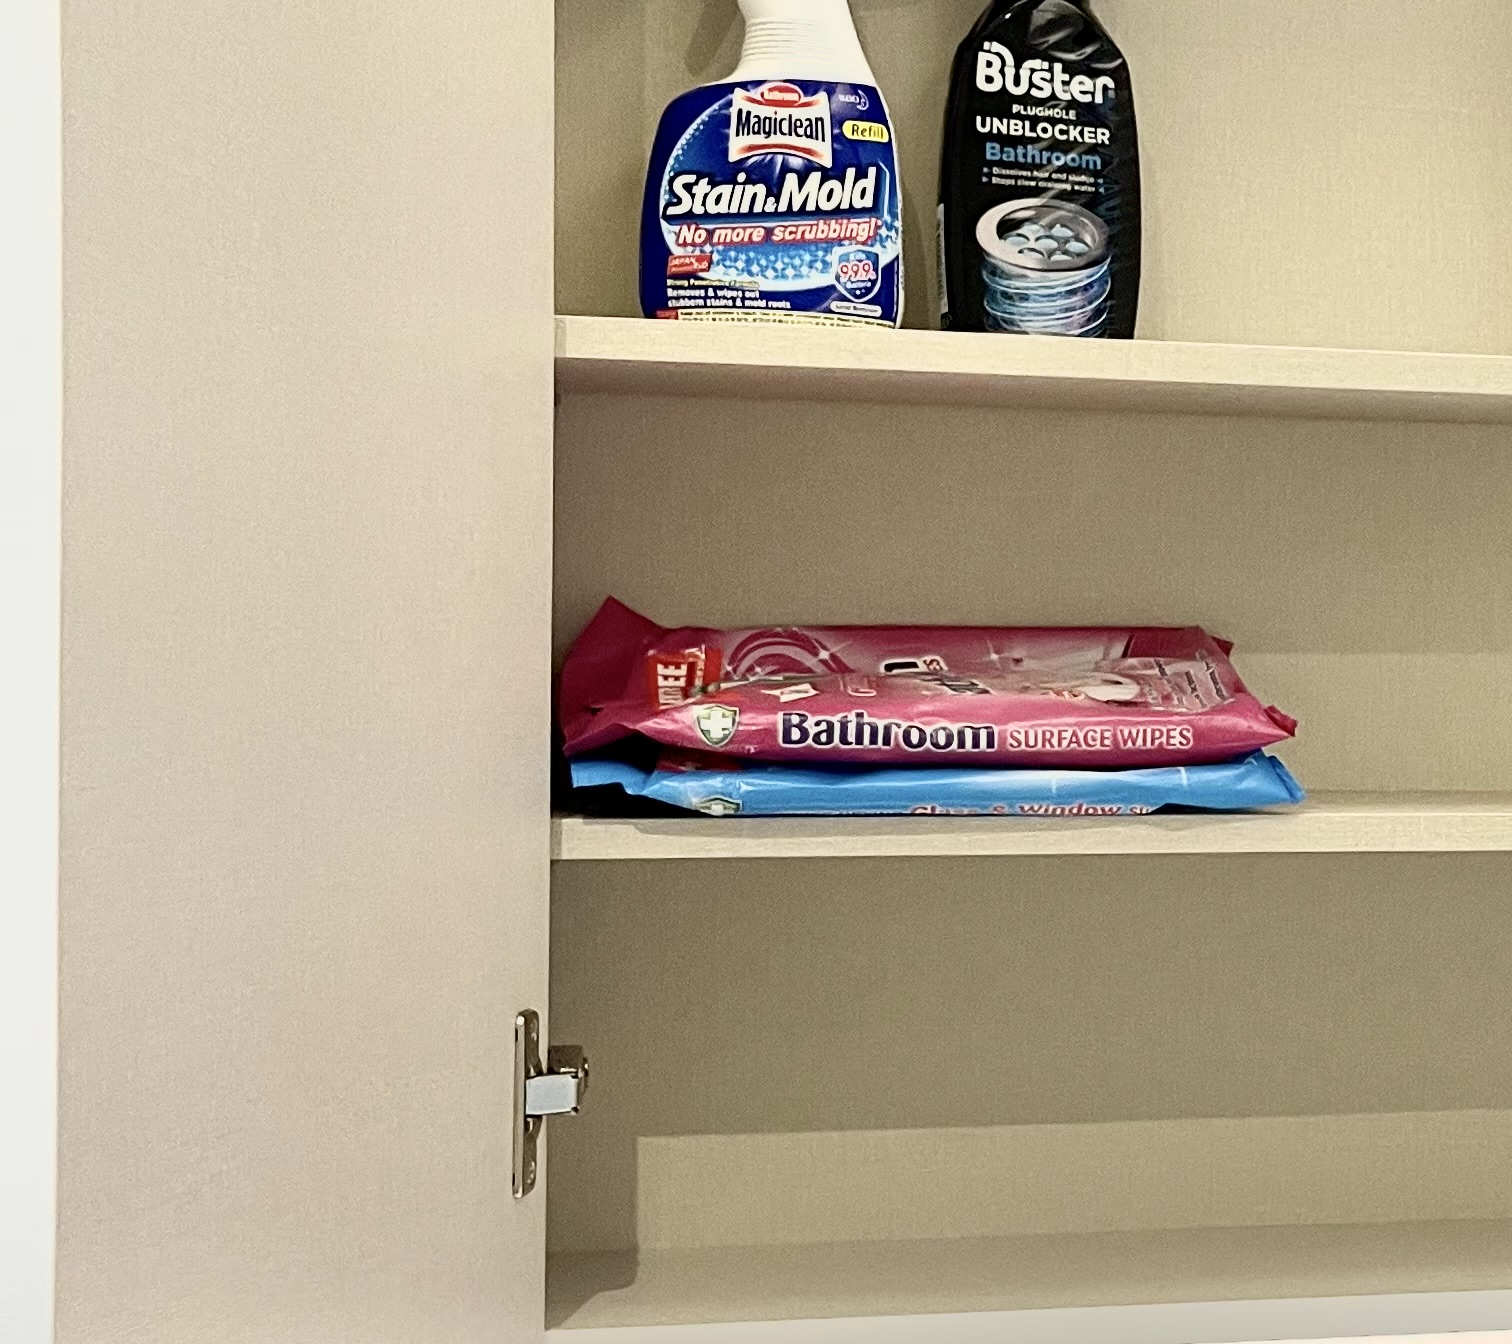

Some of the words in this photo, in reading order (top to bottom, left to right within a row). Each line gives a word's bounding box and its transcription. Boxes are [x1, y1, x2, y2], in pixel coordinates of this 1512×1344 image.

[976, 41, 1115, 104] Buster
[735, 108, 826, 143] Magiclean
[1012, 104, 1077, 120] PLUGHOLE
[851, 123, 884, 140] Refill
[976, 116, 1111, 145] UNBLOCKER
[985, 142, 1102, 170] Bathroom
[666, 172, 767, 215] Stain
[778, 167, 877, 212] Mold
[678, 225, 707, 244] No
[713, 226, 765, 244] more
[782, 712, 996, 751] Bathroom
[1008, 729, 1112, 749] SURFACE
[1118, 727, 1192, 748] WIPES
